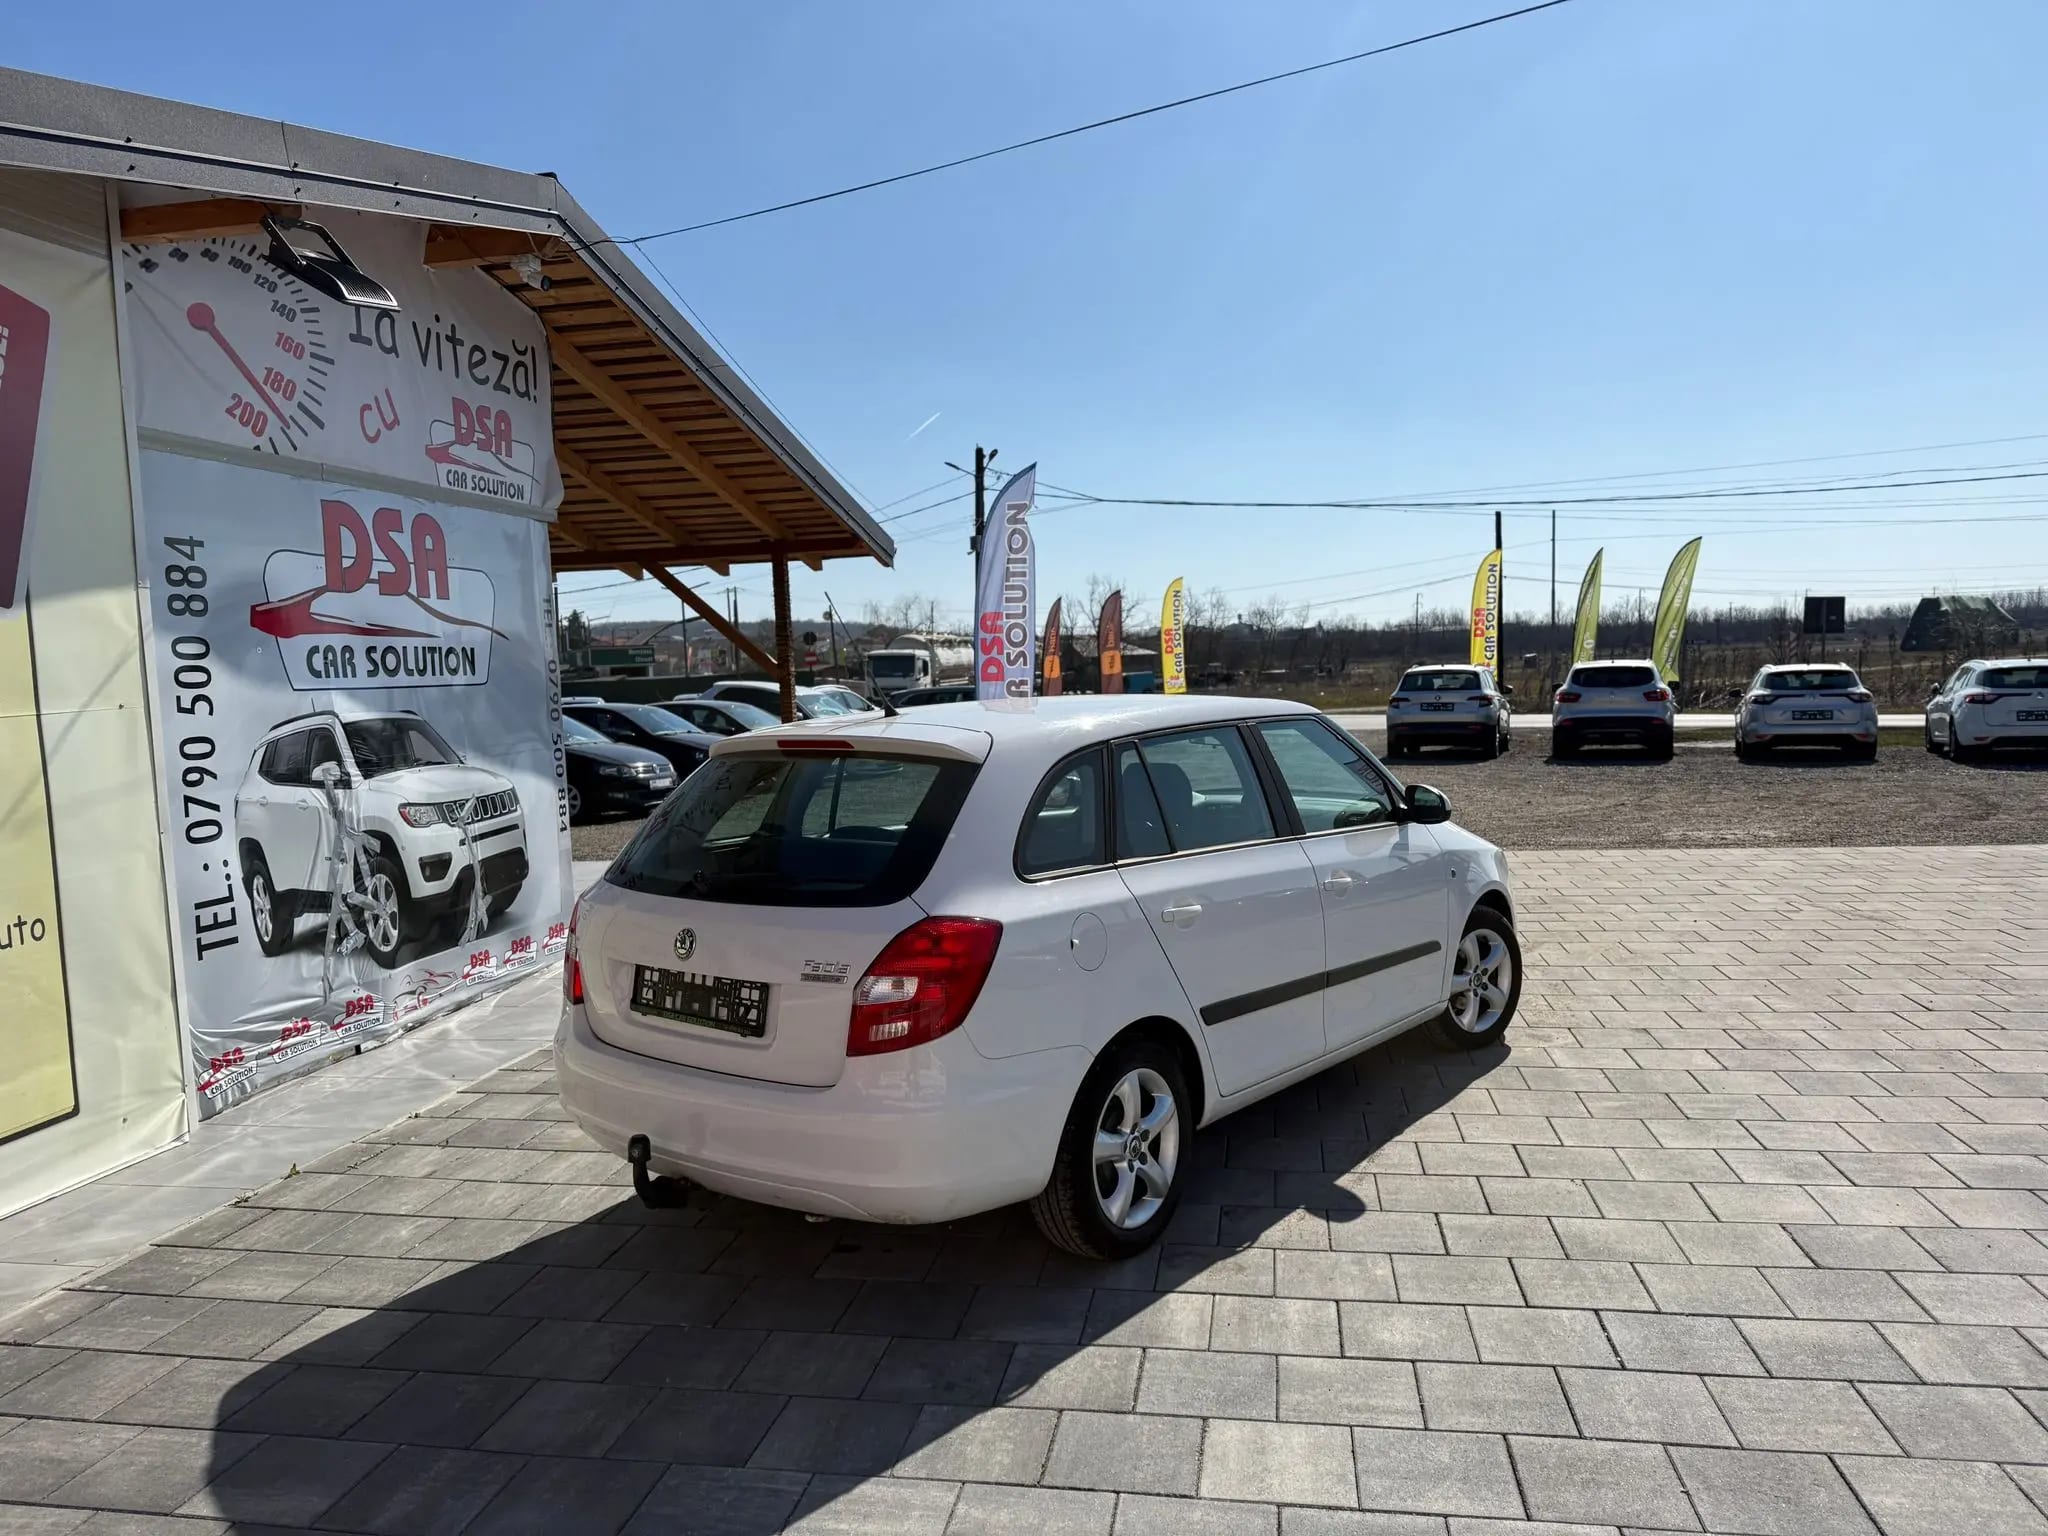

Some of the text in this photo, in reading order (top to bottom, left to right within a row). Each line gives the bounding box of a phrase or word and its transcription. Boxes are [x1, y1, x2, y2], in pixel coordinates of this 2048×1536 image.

[227, 255, 253, 274] 100
[253, 273, 278, 293] 120
[270, 299, 297, 323] 140
[274, 331, 306, 360] 160
[412, 314, 538, 404] viteză!
[262, 366, 297, 402] 180
[225, 393, 268, 437] 200
[359, 388, 400, 444] cu
[452, 396, 512, 458] DSA
[446, 469, 524, 500] CAR SOLUTION
[320, 499, 450, 600] DSA
[1004, 501, 1029, 669] SOLUTION
[1485, 563, 1498, 631] SOLUTION
[1173, 590, 1182, 649] SOLUTION
[1473, 608, 1485, 638] DSA
[980, 610, 1004, 683] DSA
[1164, 628, 1174, 655] DSA
[1484, 635, 1495, 661] CAR
[306, 645, 476, 679] CAR SOLUTION
[1174, 652, 1184, 674] CAR
[548, 659, 560, 722] 0790
[163, 536, 239, 961] TEL.: 0790 500 884
[551, 732, 565, 778] 500
[557, 786, 568, 833] 884
[511, 936, 531, 955] DSA
[549, 922, 565, 940] DSA
[470, 949, 490, 969] DSA
[344, 994, 375, 1018] DSA
[352, 1017, 381, 1032] SOLUTION
[289, 1039, 318, 1056] SOLUTION
[224, 1066, 254, 1087] SOLUTION
